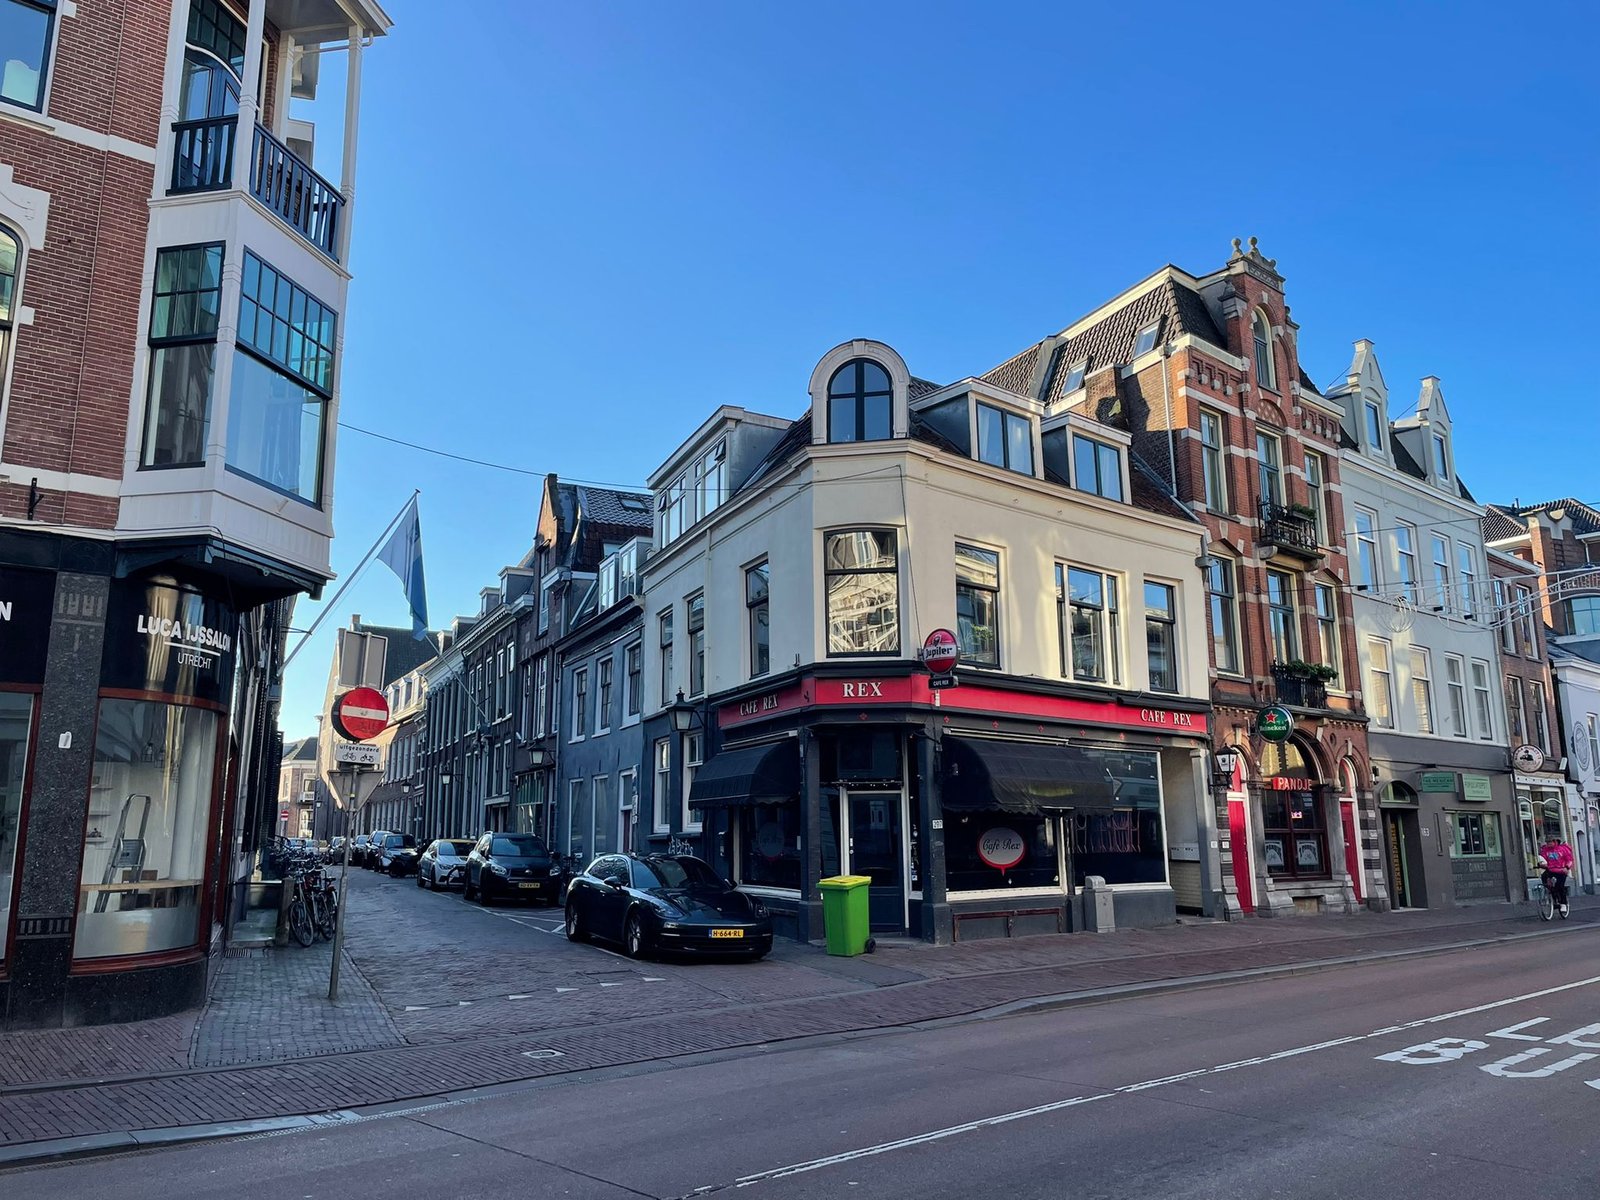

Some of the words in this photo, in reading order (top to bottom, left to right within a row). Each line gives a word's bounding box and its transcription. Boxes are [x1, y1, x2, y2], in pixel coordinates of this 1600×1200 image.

[137, 614, 182, 639] LUCA
[186, 627, 231, 653] IJSSALON
[925, 646, 953, 658] Jupiler
[177, 651, 212, 670] UTRECHT
[842, 682, 883, 698] REX
[739, 698, 758, 716] CAFE
[763, 694, 778, 711] REX
[1141, 709, 1166, 724] CAFE
[1173, 712, 1192, 726] REX
[339, 744, 380, 753] uitgezonderd
[1278, 777, 1312, 791] PANDJE
[1002, 839, 1021, 850] Rex
